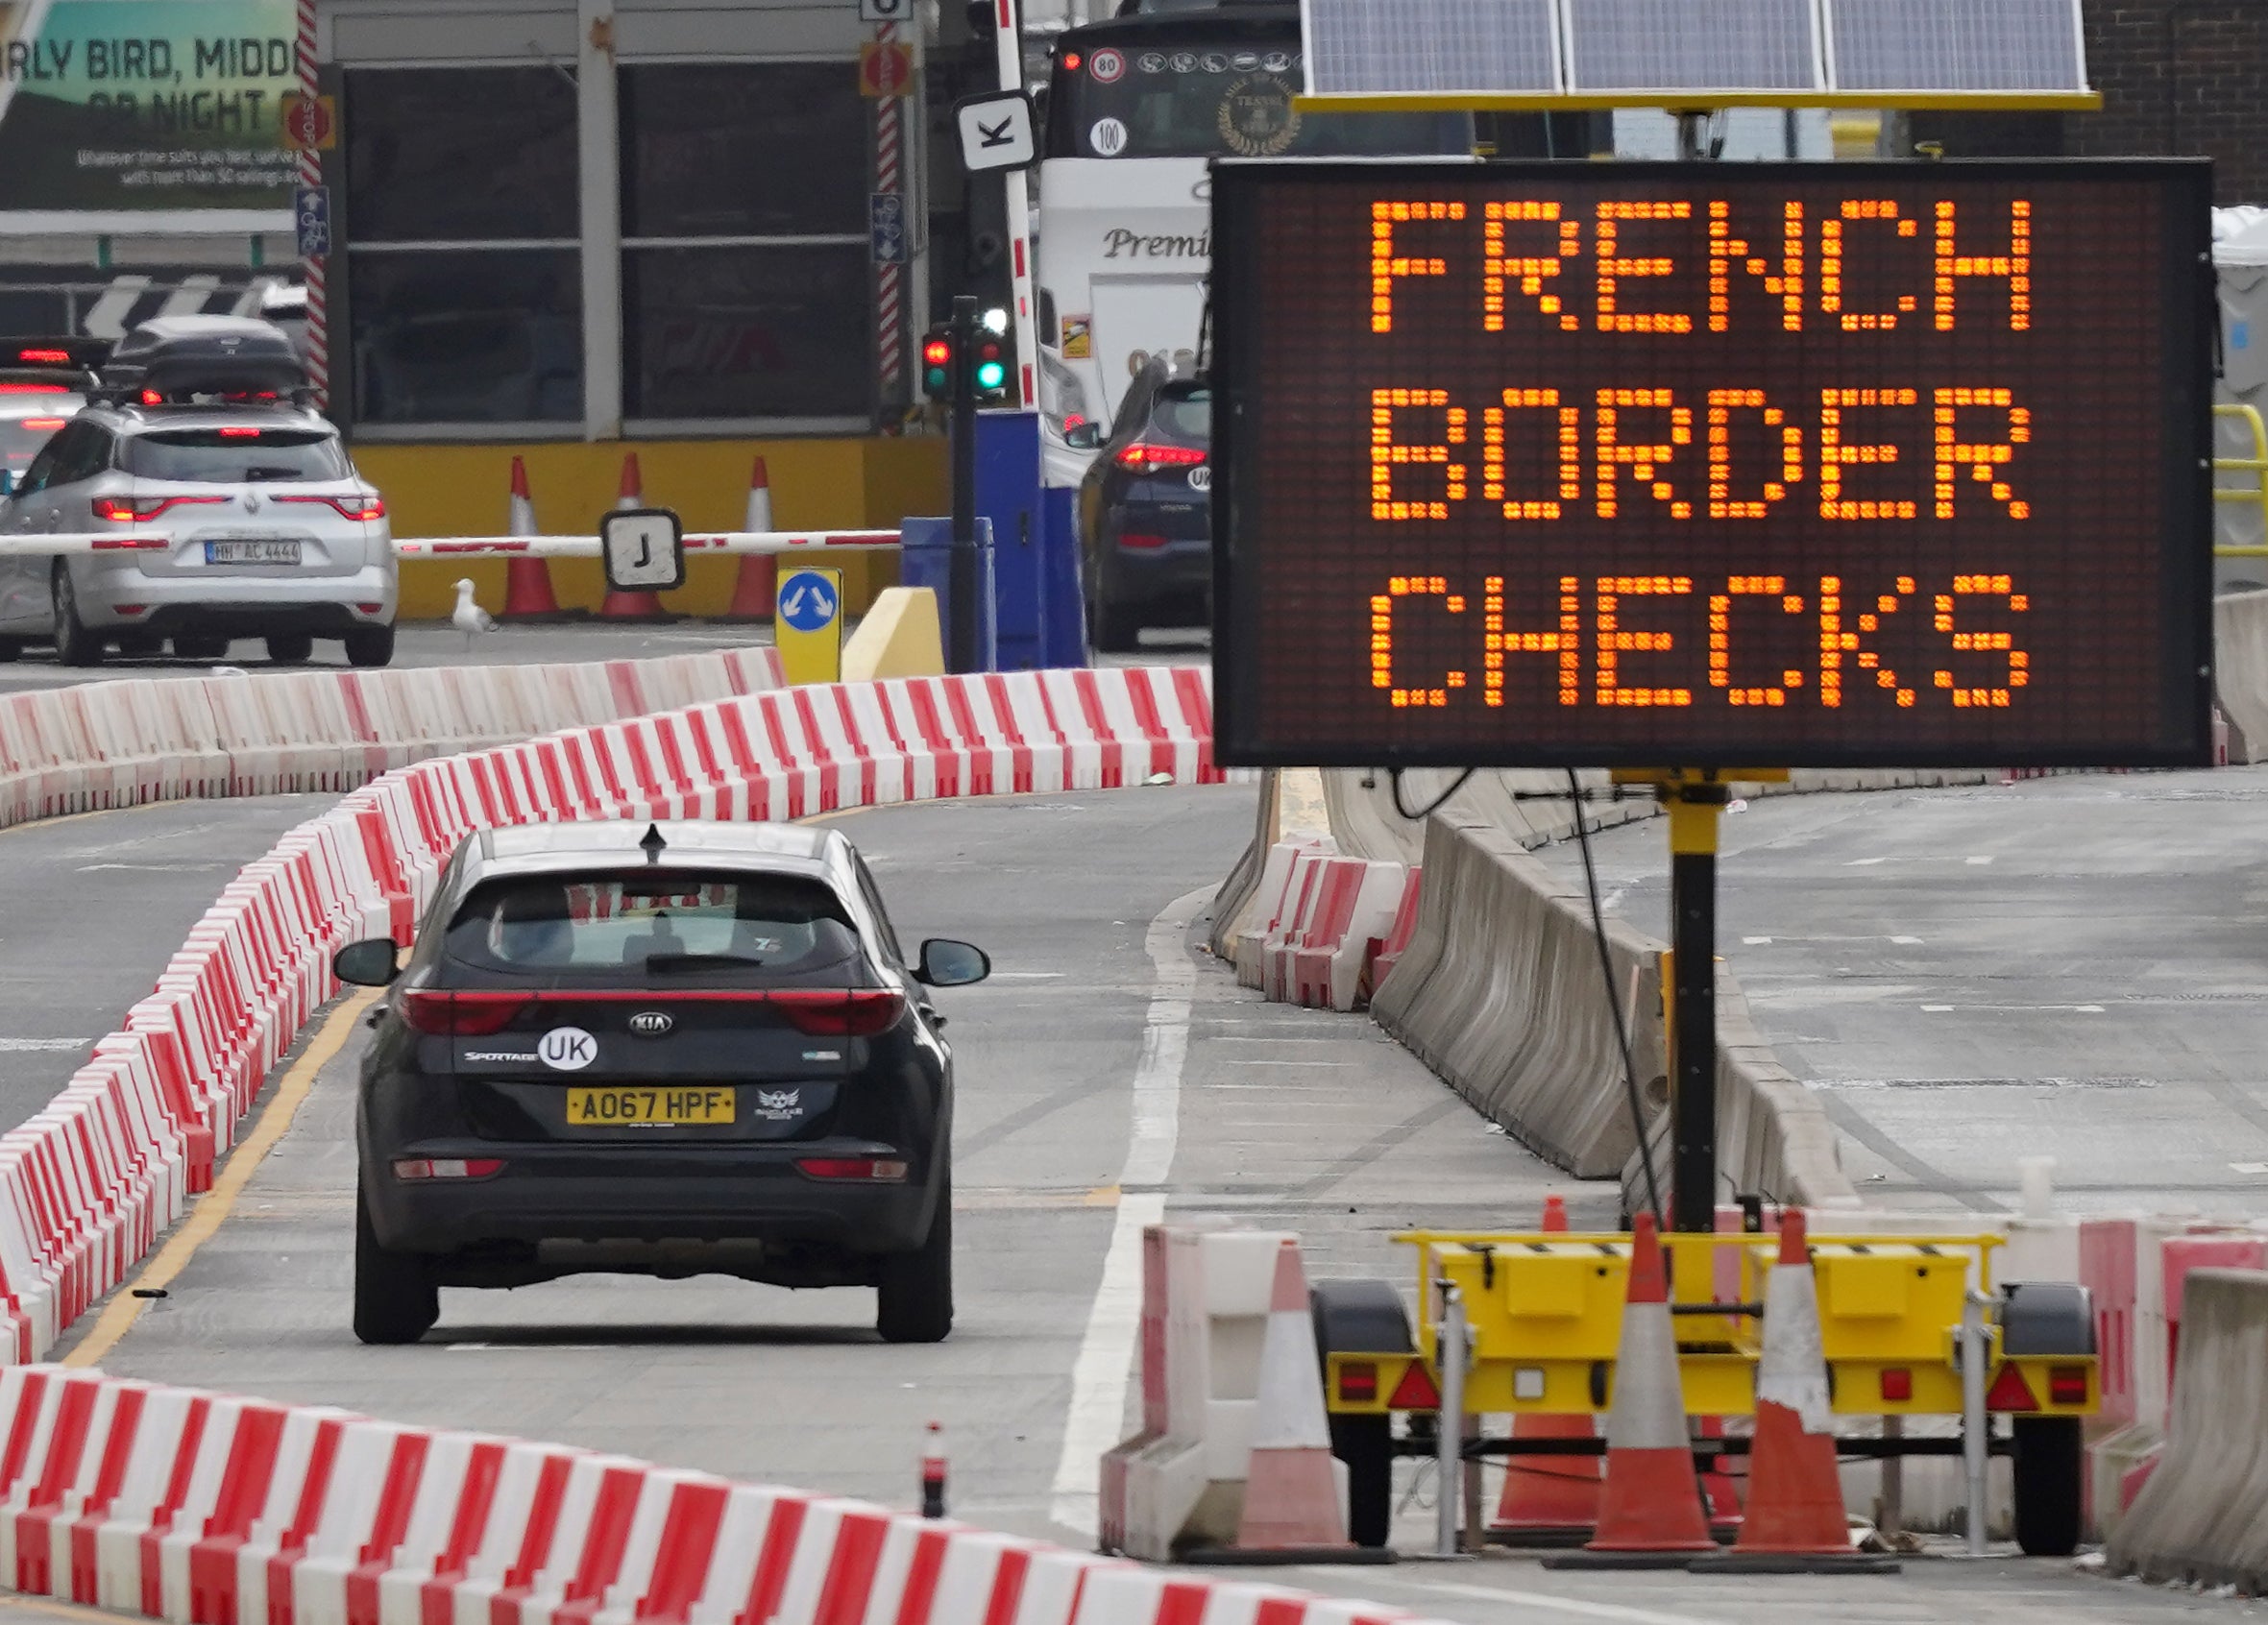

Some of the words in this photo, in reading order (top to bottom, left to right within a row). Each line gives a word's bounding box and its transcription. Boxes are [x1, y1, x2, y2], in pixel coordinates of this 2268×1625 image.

[0, 38, 74, 81] RLY
[87, 38, 183, 85] BIRD,
[1098, 59, 1116, 72] 80
[154, 90, 265, 131] NIGHT
[303, 101, 315, 143] STOP
[978, 114, 1015, 148] K
[1099, 123, 1119, 151] 100
[1103, 228, 1211, 257] Premi
[1372, 201, 2030, 332] FRENCH
[1372, 389, 2030, 519] BORDER
[633, 532, 651, 568] J
[1372, 576, 2030, 706] CHECKS
[636, 1016, 666, 1030] KIA
[464, 1051, 540, 1061] SPORTAGE
[546, 1035, 590, 1061] UK
[667, 1092, 722, 1119] HPF
